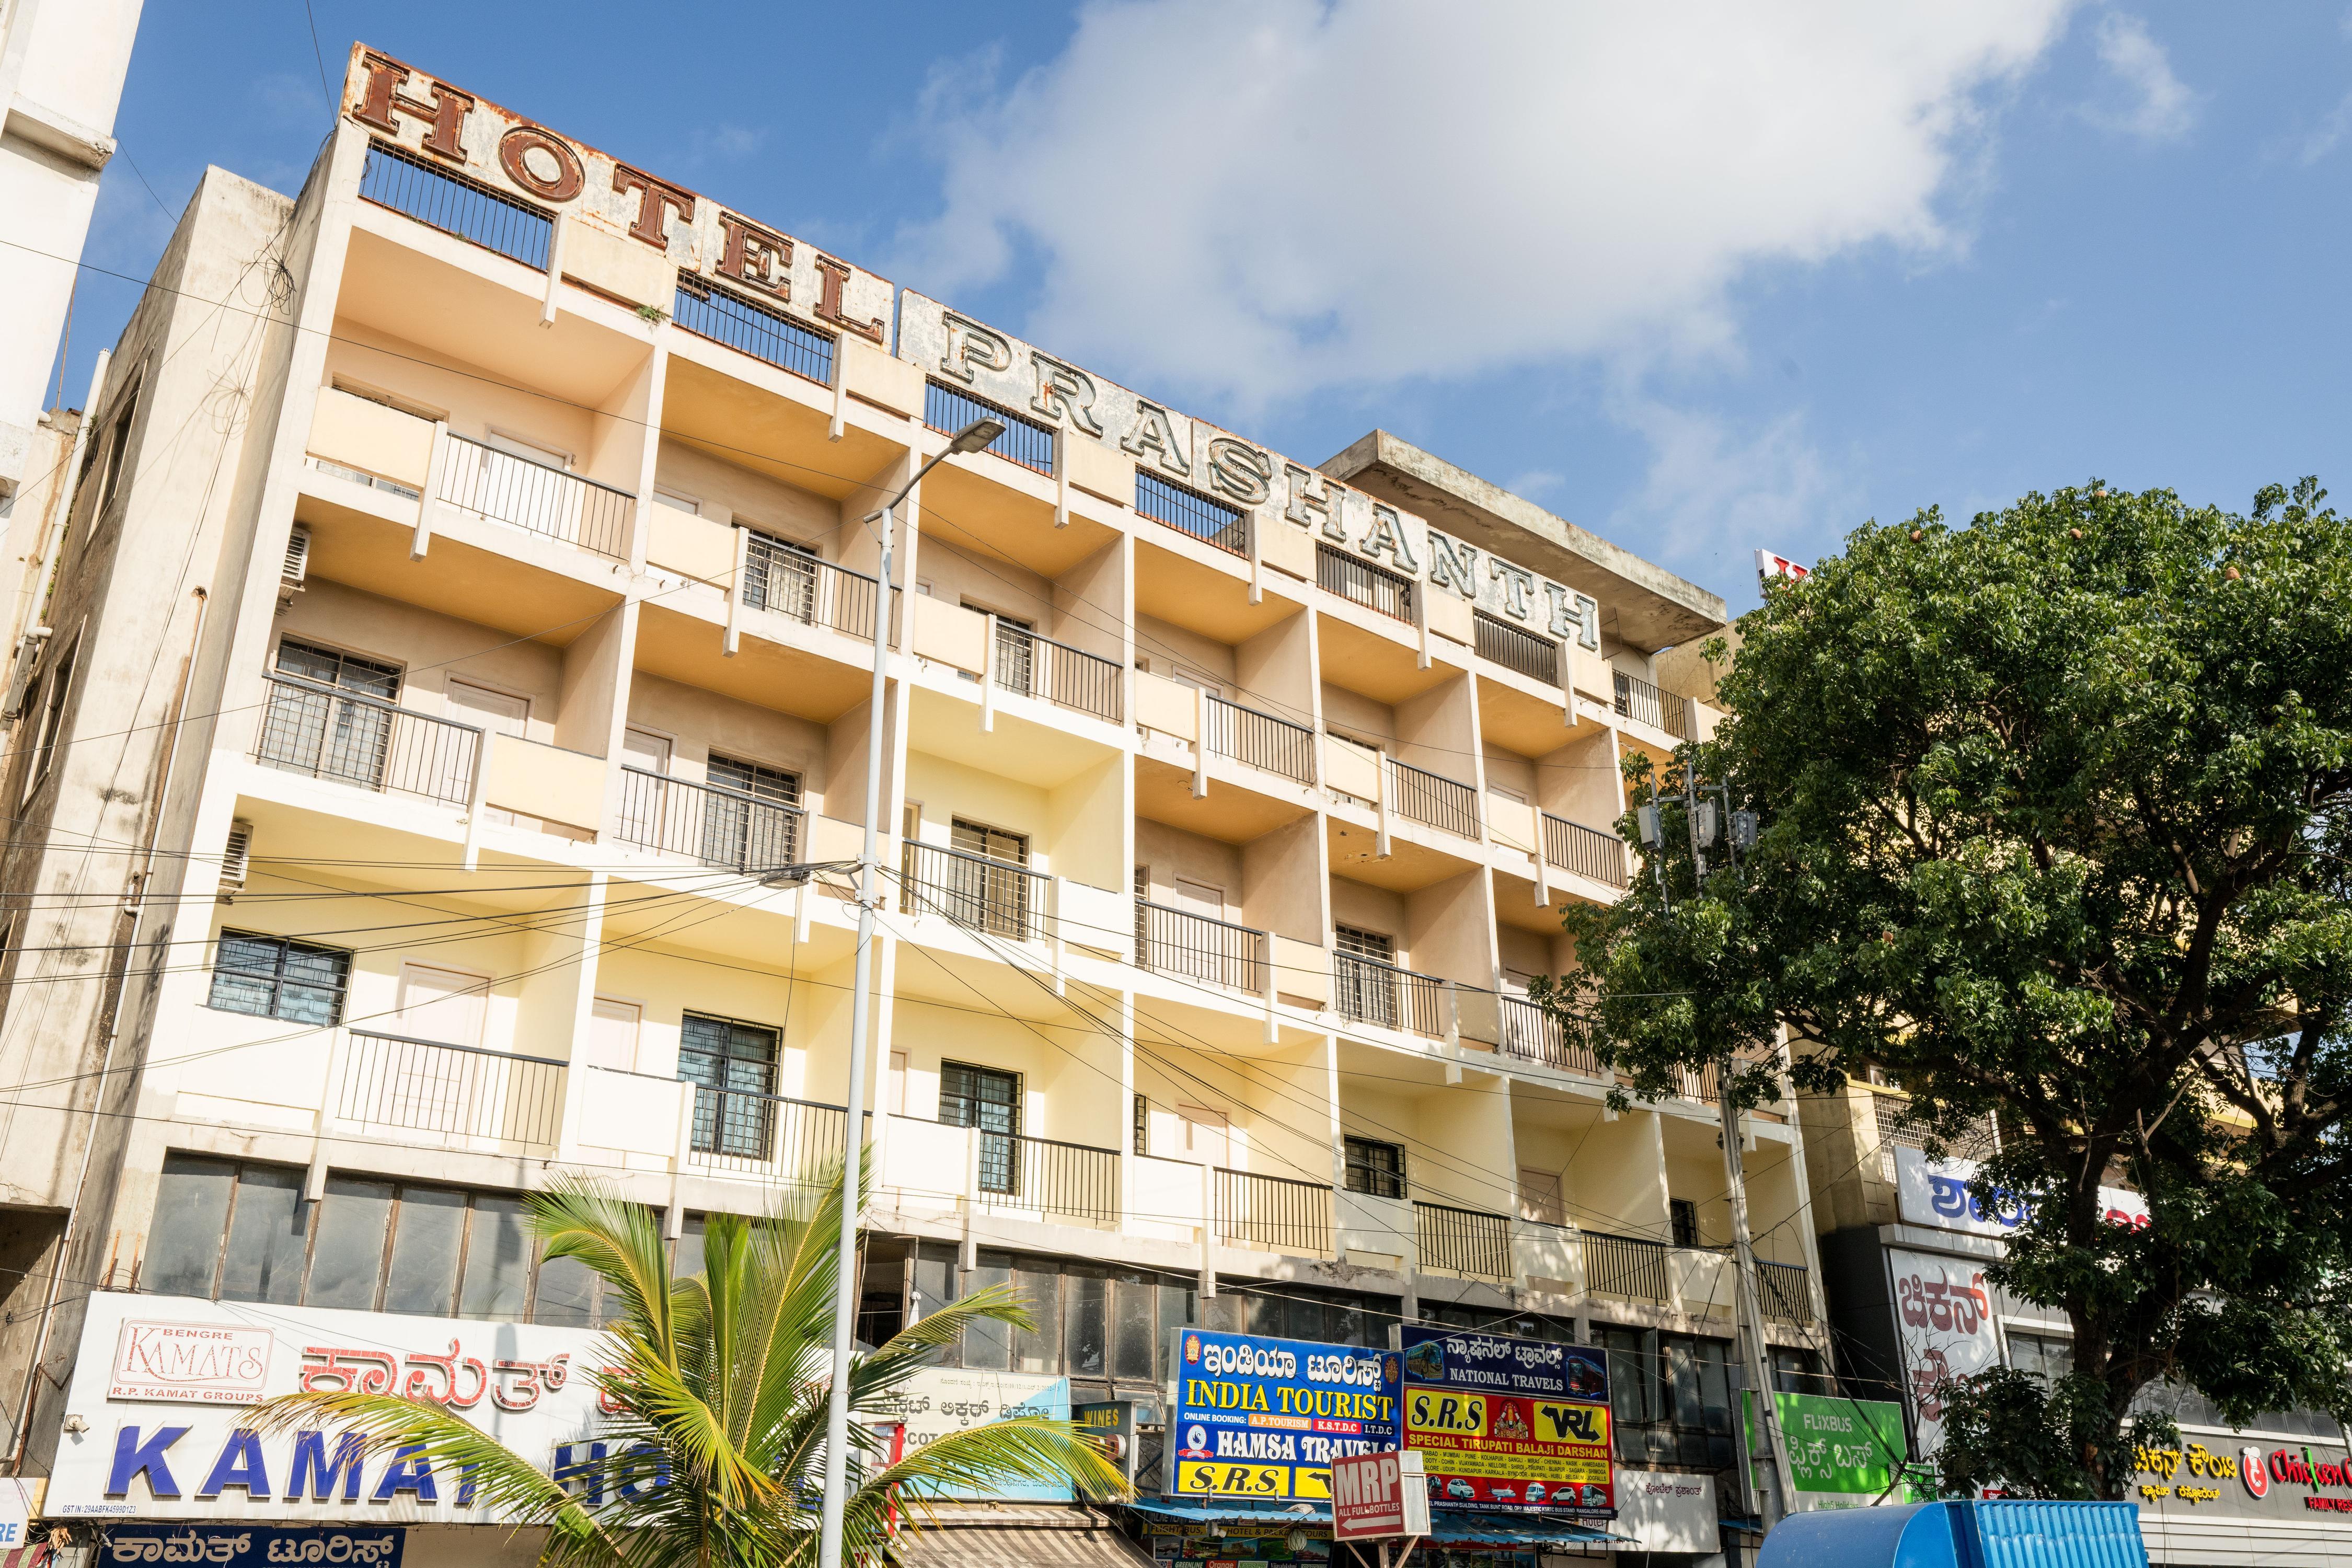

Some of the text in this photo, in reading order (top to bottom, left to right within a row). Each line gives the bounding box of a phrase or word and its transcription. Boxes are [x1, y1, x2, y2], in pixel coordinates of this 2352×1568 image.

[353, 51, 1598, 650] HOTEL PRASHANTH
[1898, 1266, 1989, 1334] ಚಿಕನ್
[163, 1329, 234, 1340] BENGRE
[122, 1327, 263, 1380] KAMATS
[1446, 1336, 1511, 1364] ನ್ಯಾಷನಲ್
[302, 1338, 570, 1410] ಕಾಮತ್
[1204, 1343, 1382, 1392] ಇಂಡಿಯಾ ಟೂರಿಸ್ಟ್
[1449, 1367, 1563, 1391] NATIONAL TRAVELS
[112, 1387, 264, 1402] R.P. KAMAT GROUPS
[1185, 1379, 1394, 1421] INDIA TOURIST
[1084, 1408, 1119, 1426] WINES
[1184, 1412, 1392, 1435] ONLINE BOOKING: A.P.TOURISM K.S.T.D.C I.T.D.C
[1411, 1395, 1483, 1431] S.R.S
[1216, 1430, 1297, 1461] HAMSA
[1409, 1434, 1608, 1459] SPECIAL TIRUPATI BALAJI DARSHAN
[1834, 1441, 1872, 1469] ಬಸ್
[2188, 1443, 2238, 1478] ಕೌಂಟಿ
[2272, 1446, 2345, 1493] Chicken
[1190, 1466, 1280, 1492] S.R.S
[1335, 1458, 1399, 1507] MRP
[1645, 1482, 1673, 1495] ಹೋಟೆಲ್
[1338, 1502, 1400, 1517] ALL FULL BOTTLES
[1818, 1500, 1835, 1510] High5
[2308, 1496, 2335, 1510] FAMILY
[1185, 1526, 1203, 1535] BUS,
[1227, 1527, 1253, 1536] HOTEL
[1582, 1518, 1604, 1527] Hotel
[111, 1532, 251, 1563] ಕಾಮತ್
